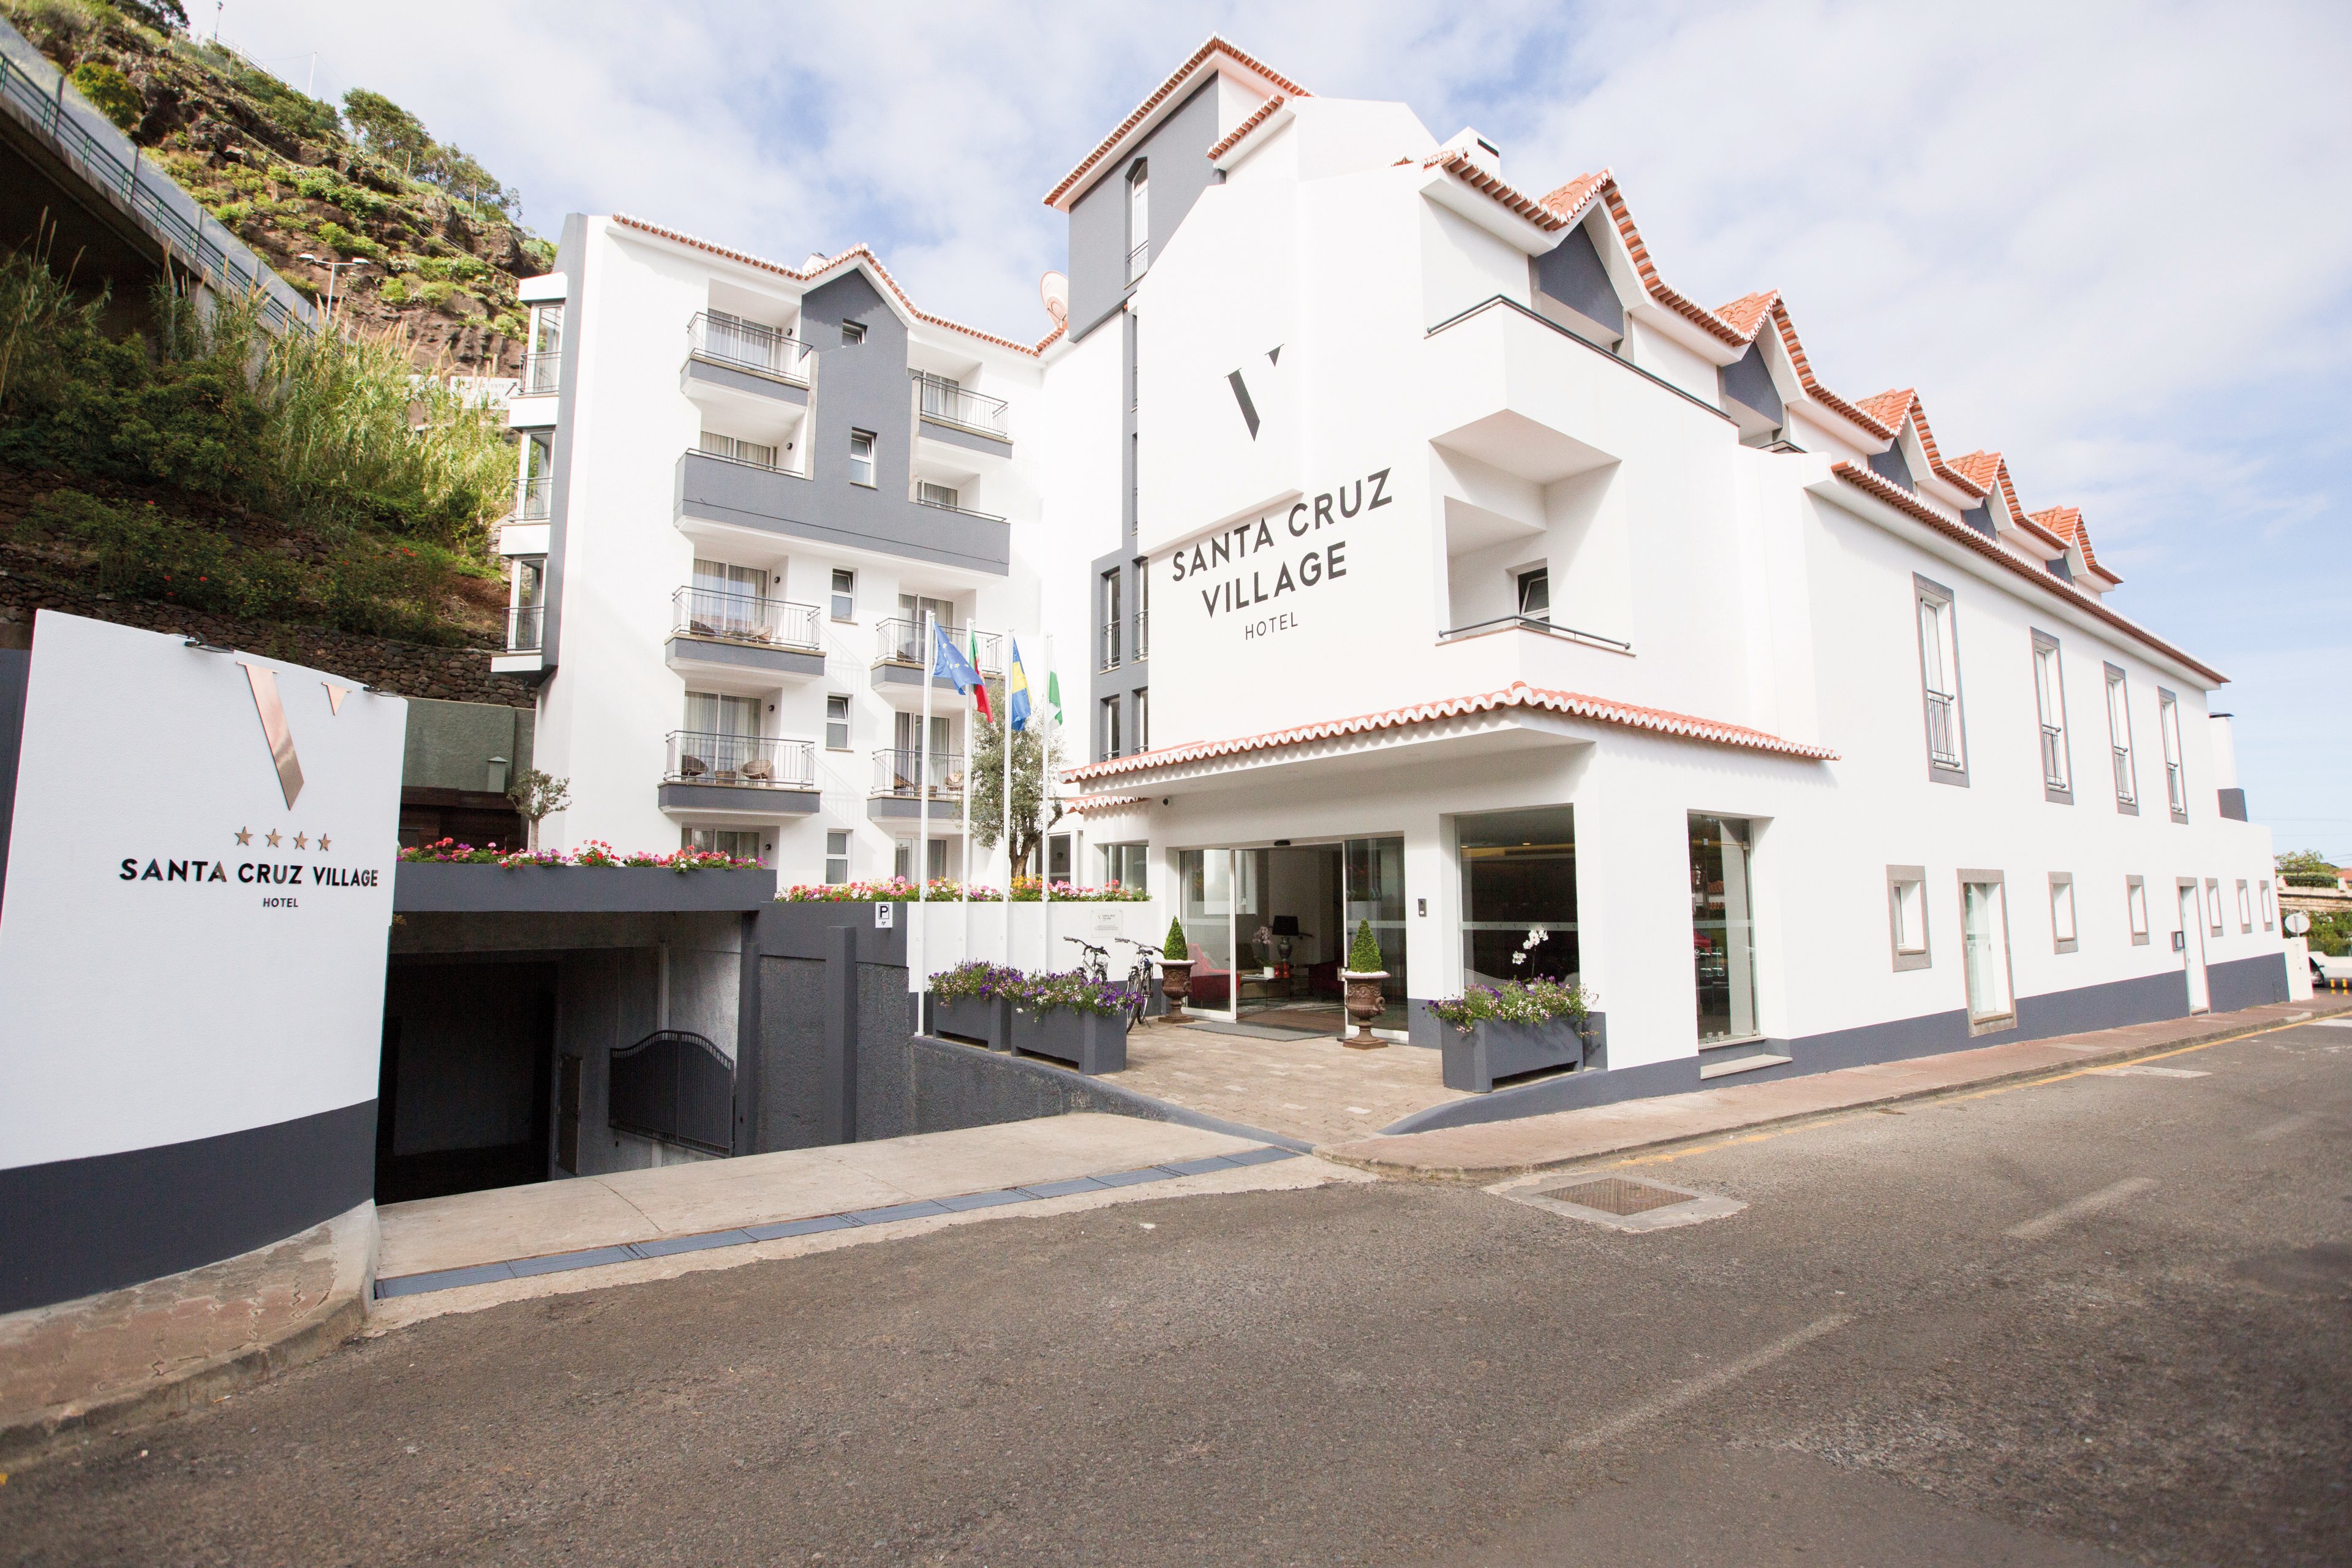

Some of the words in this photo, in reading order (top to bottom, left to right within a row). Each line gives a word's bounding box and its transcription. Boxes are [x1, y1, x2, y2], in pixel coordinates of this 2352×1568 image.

[1172, 516, 1274, 582] SANTA
[1288, 467, 1392, 537] CRUZ
[1202, 540, 1347, 618] VILLAGE
[1245, 611, 1298, 640] HOTEL
[119, 858, 227, 883] SANTA
[238, 862, 304, 884] CRUZ
[312, 866, 379, 887] VILLAGE
[263, 897, 299, 908] HOTEL
[880, 905, 889, 918] P
